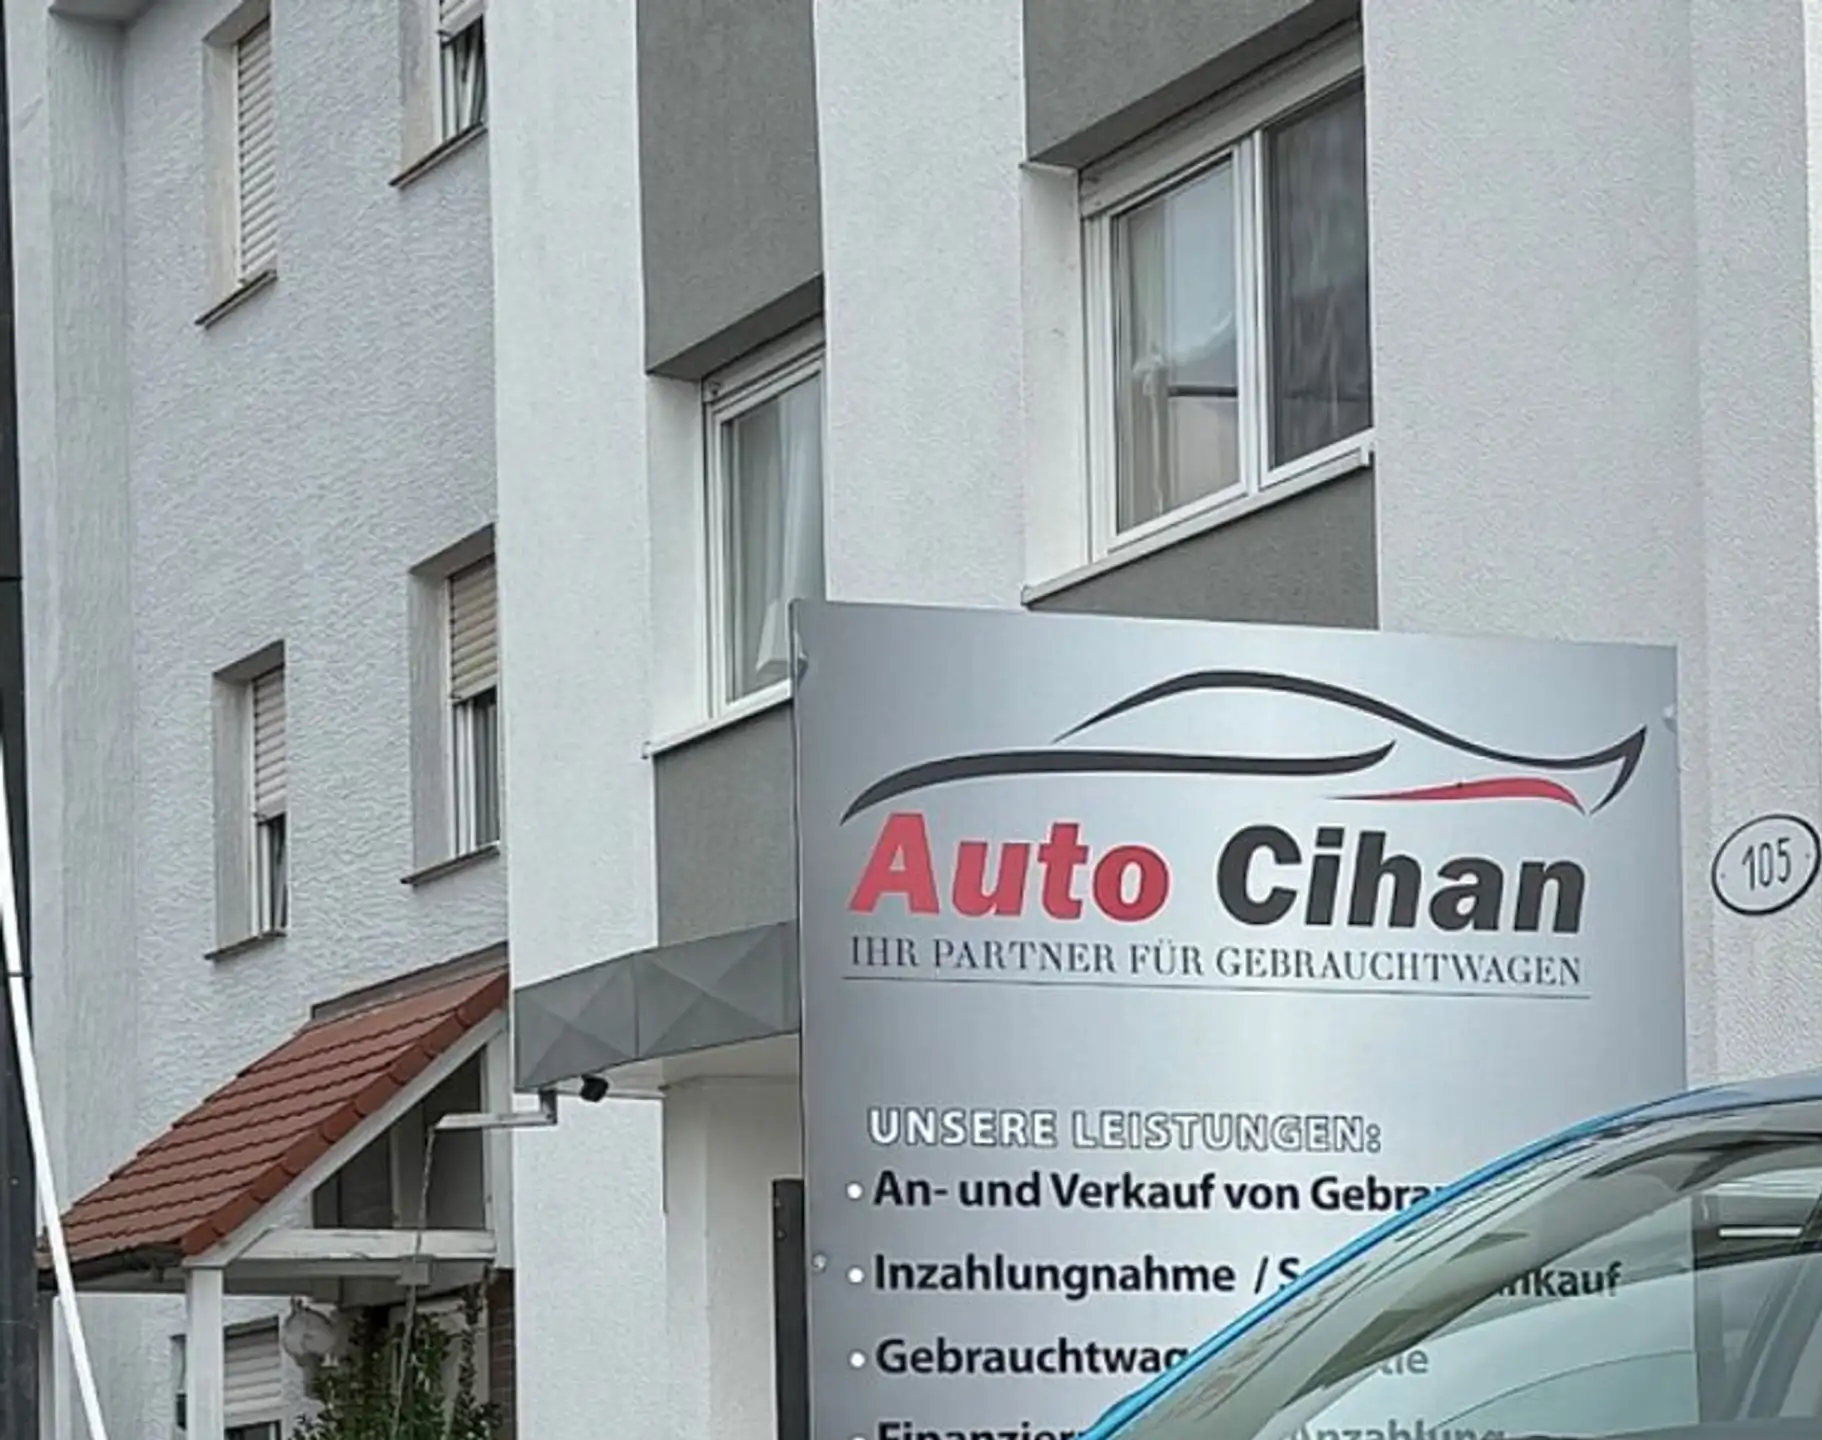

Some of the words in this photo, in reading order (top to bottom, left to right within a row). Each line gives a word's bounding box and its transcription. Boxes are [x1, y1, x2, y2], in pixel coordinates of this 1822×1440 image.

[847, 812, 1170, 923] Auto
[1217, 824, 1585, 934] Cihan
[1741, 837, 1791, 891] 105
[851, 935, 920, 968] IHR
[933, 938, 1118, 974] PARTNER
[1130, 938, 1205, 976] FÜR
[1215, 946, 1581, 986] GEBRAUCHTWAGEN
[868, 1106, 1057, 1148] UNSERE
[1071, 1110, 1382, 1154] LEISTUNGEN:
[873, 1169, 948, 1206] An-
[958, 1170, 1041, 1207] und
[1050, 1171, 1215, 1209] Verkauf
[1224, 1181, 1300, 1210] von
[1310, 1174, 1444, 1212] Gebra
[874, 1253, 1237, 1301] Inzahlungnahme
